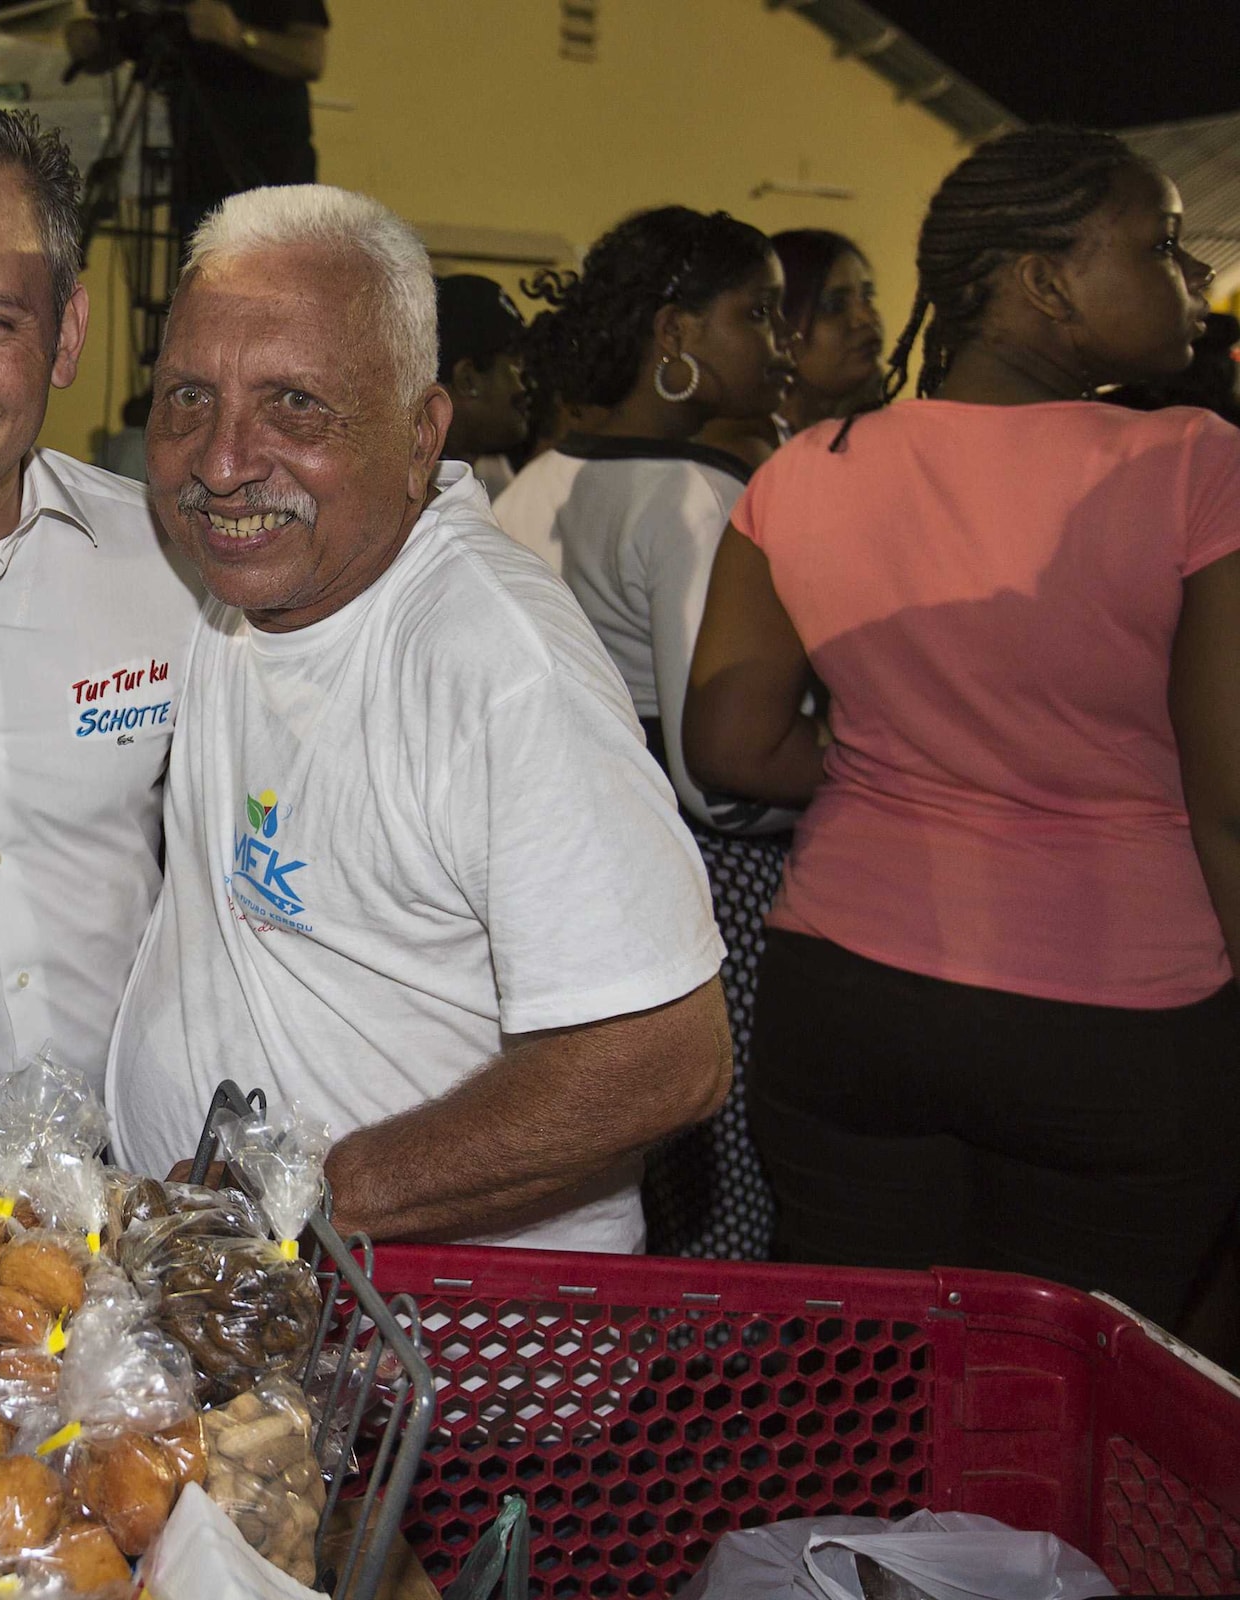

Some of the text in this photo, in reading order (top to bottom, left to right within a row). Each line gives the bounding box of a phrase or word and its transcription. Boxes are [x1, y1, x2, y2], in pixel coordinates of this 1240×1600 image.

[72, 659, 169, 704] Tur Tur ku
[76, 701, 171, 737] SCHOTTE
